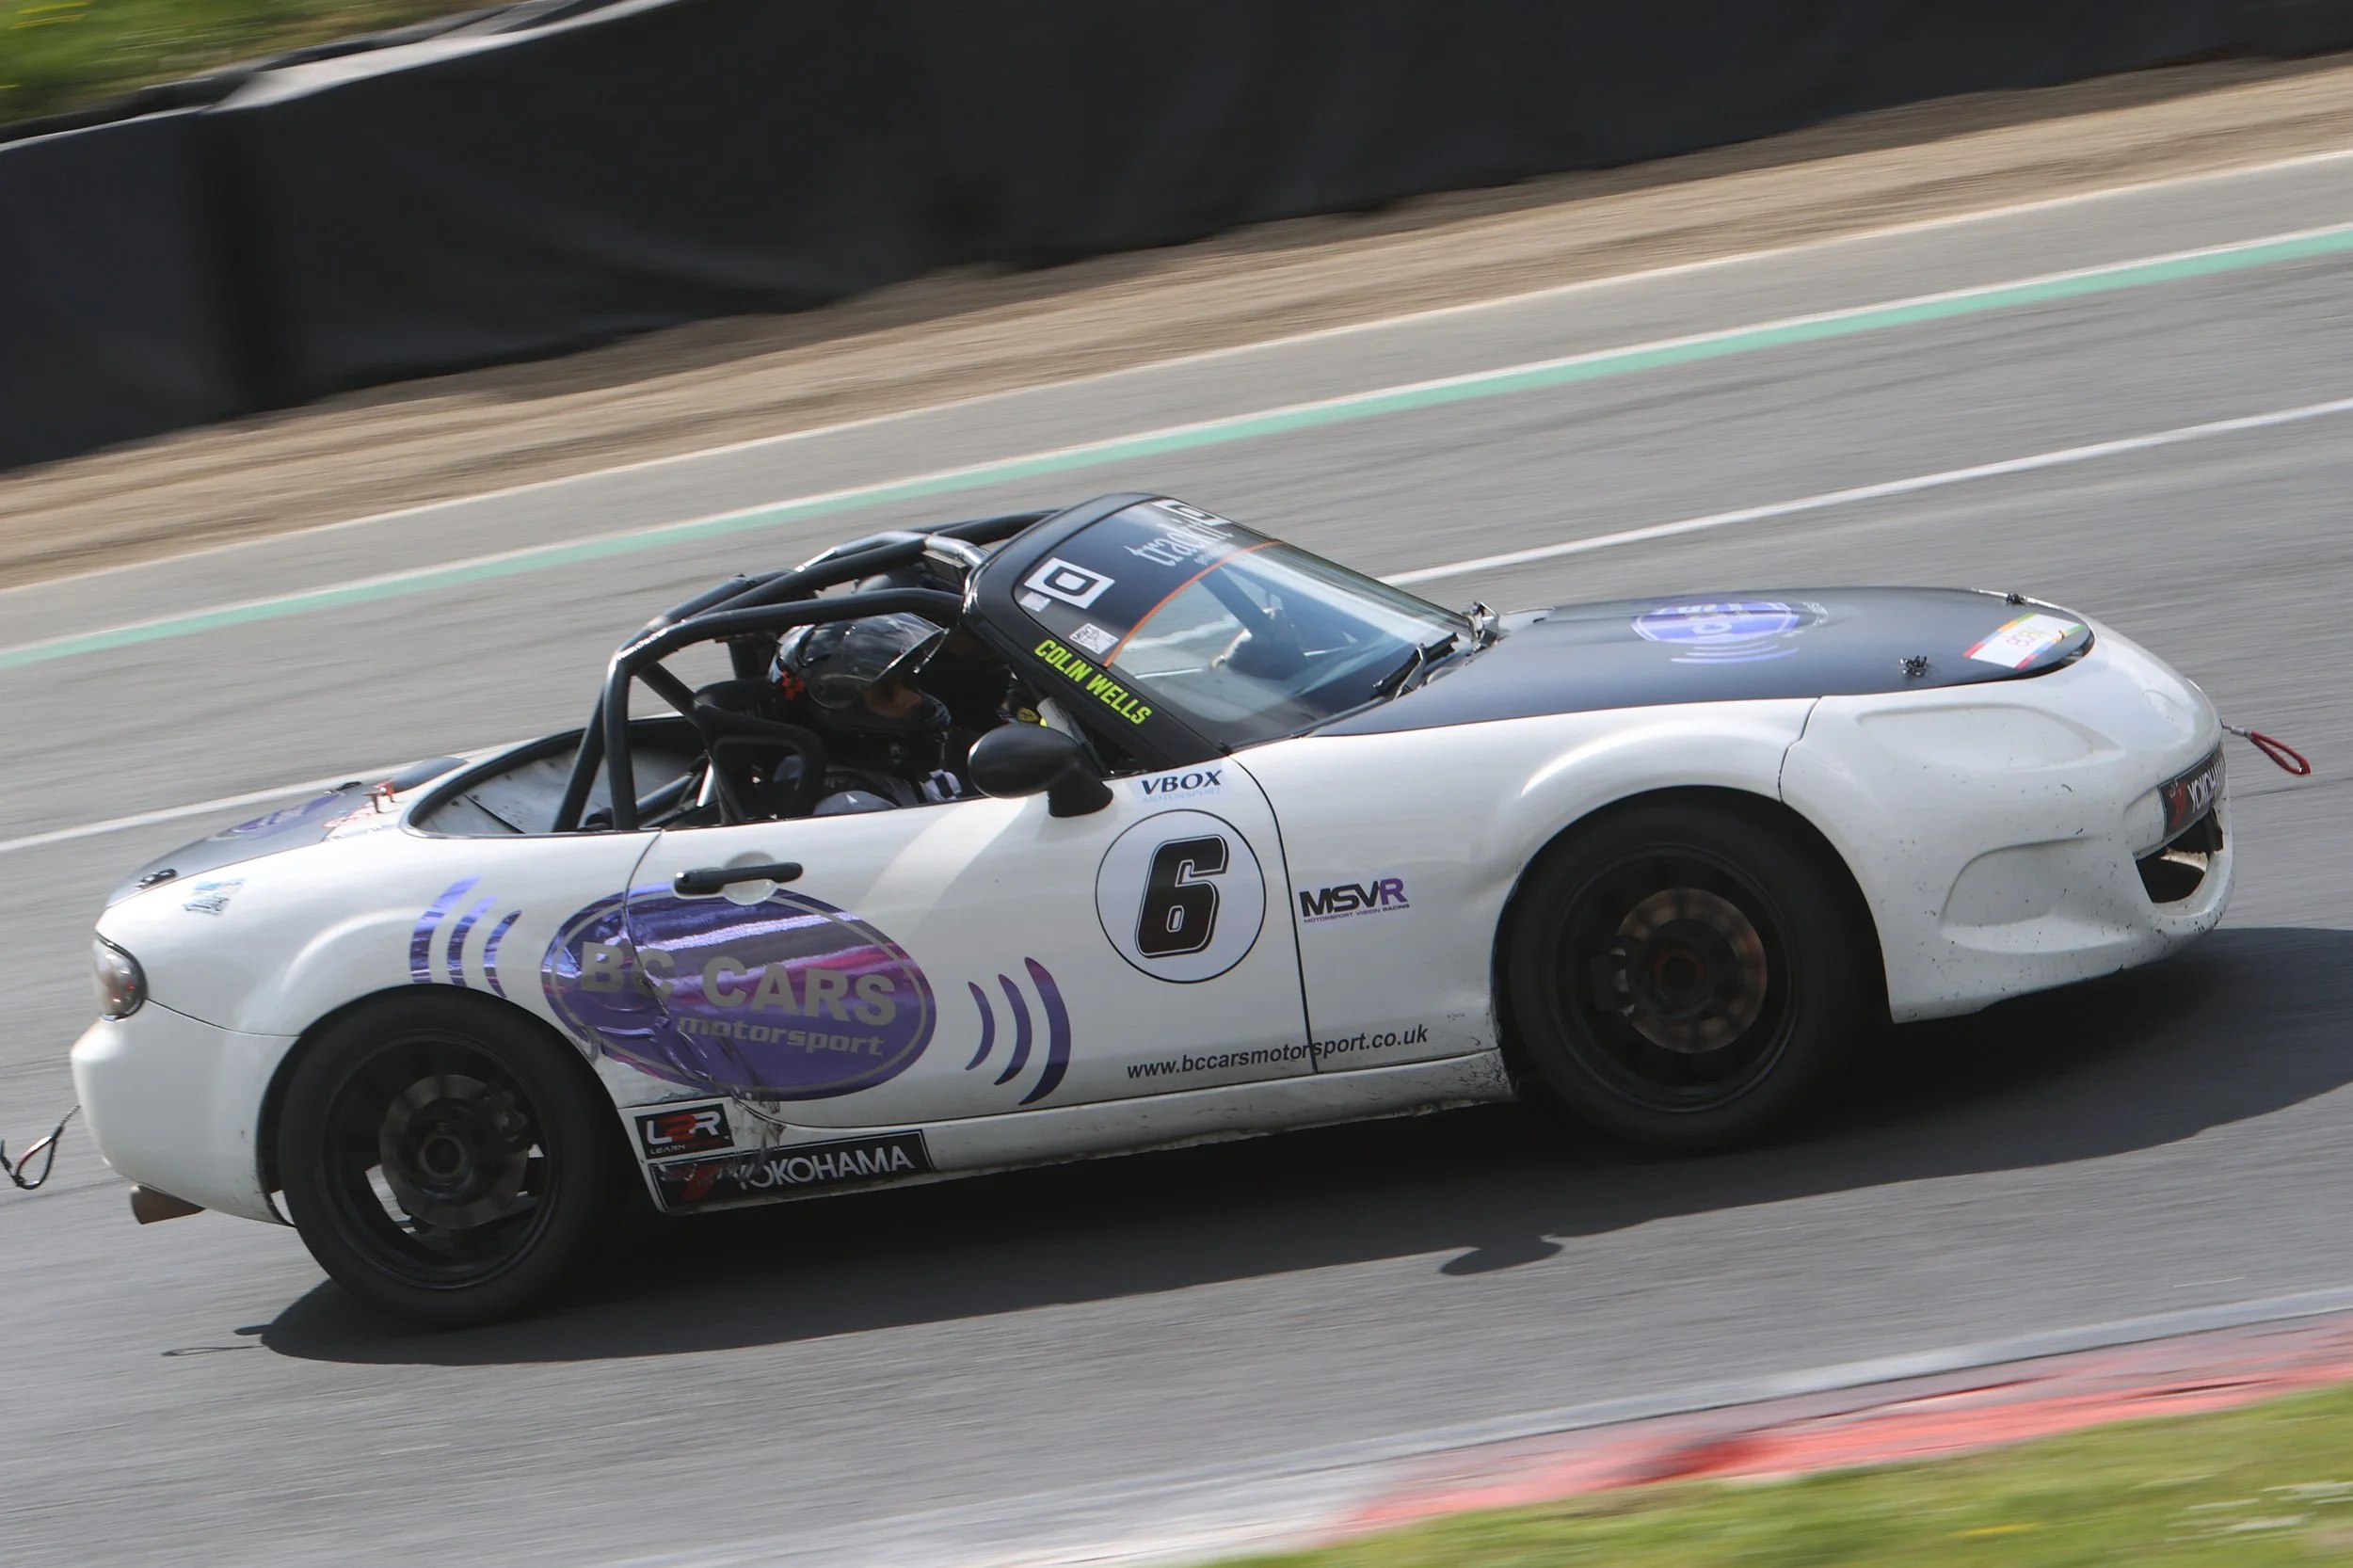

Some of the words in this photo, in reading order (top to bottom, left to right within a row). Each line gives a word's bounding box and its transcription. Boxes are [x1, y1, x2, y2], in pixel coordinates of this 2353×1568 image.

[1034, 639, 1093, 682] COLIN
[1085, 673, 1152, 725] WELLS
[1141, 769, 1223, 795] VBOX
[1134, 834, 1229, 959] 6
[1299, 877, 1409, 918] MSVR
[1304, 911, 1353, 923] MOTORSPORT
[1355, 907, 1381, 916] VISION
[1382, 903, 1411, 912] RACING
[580, 941, 676, 999] BC
[701, 955, 897, 1027] CARS
[678, 1016, 886, 1057] motorsport
[1127, 1024, 1429, 1080] www.bccarsmotorsport.co.uk
[650, 1144, 686, 1156] LEARN
